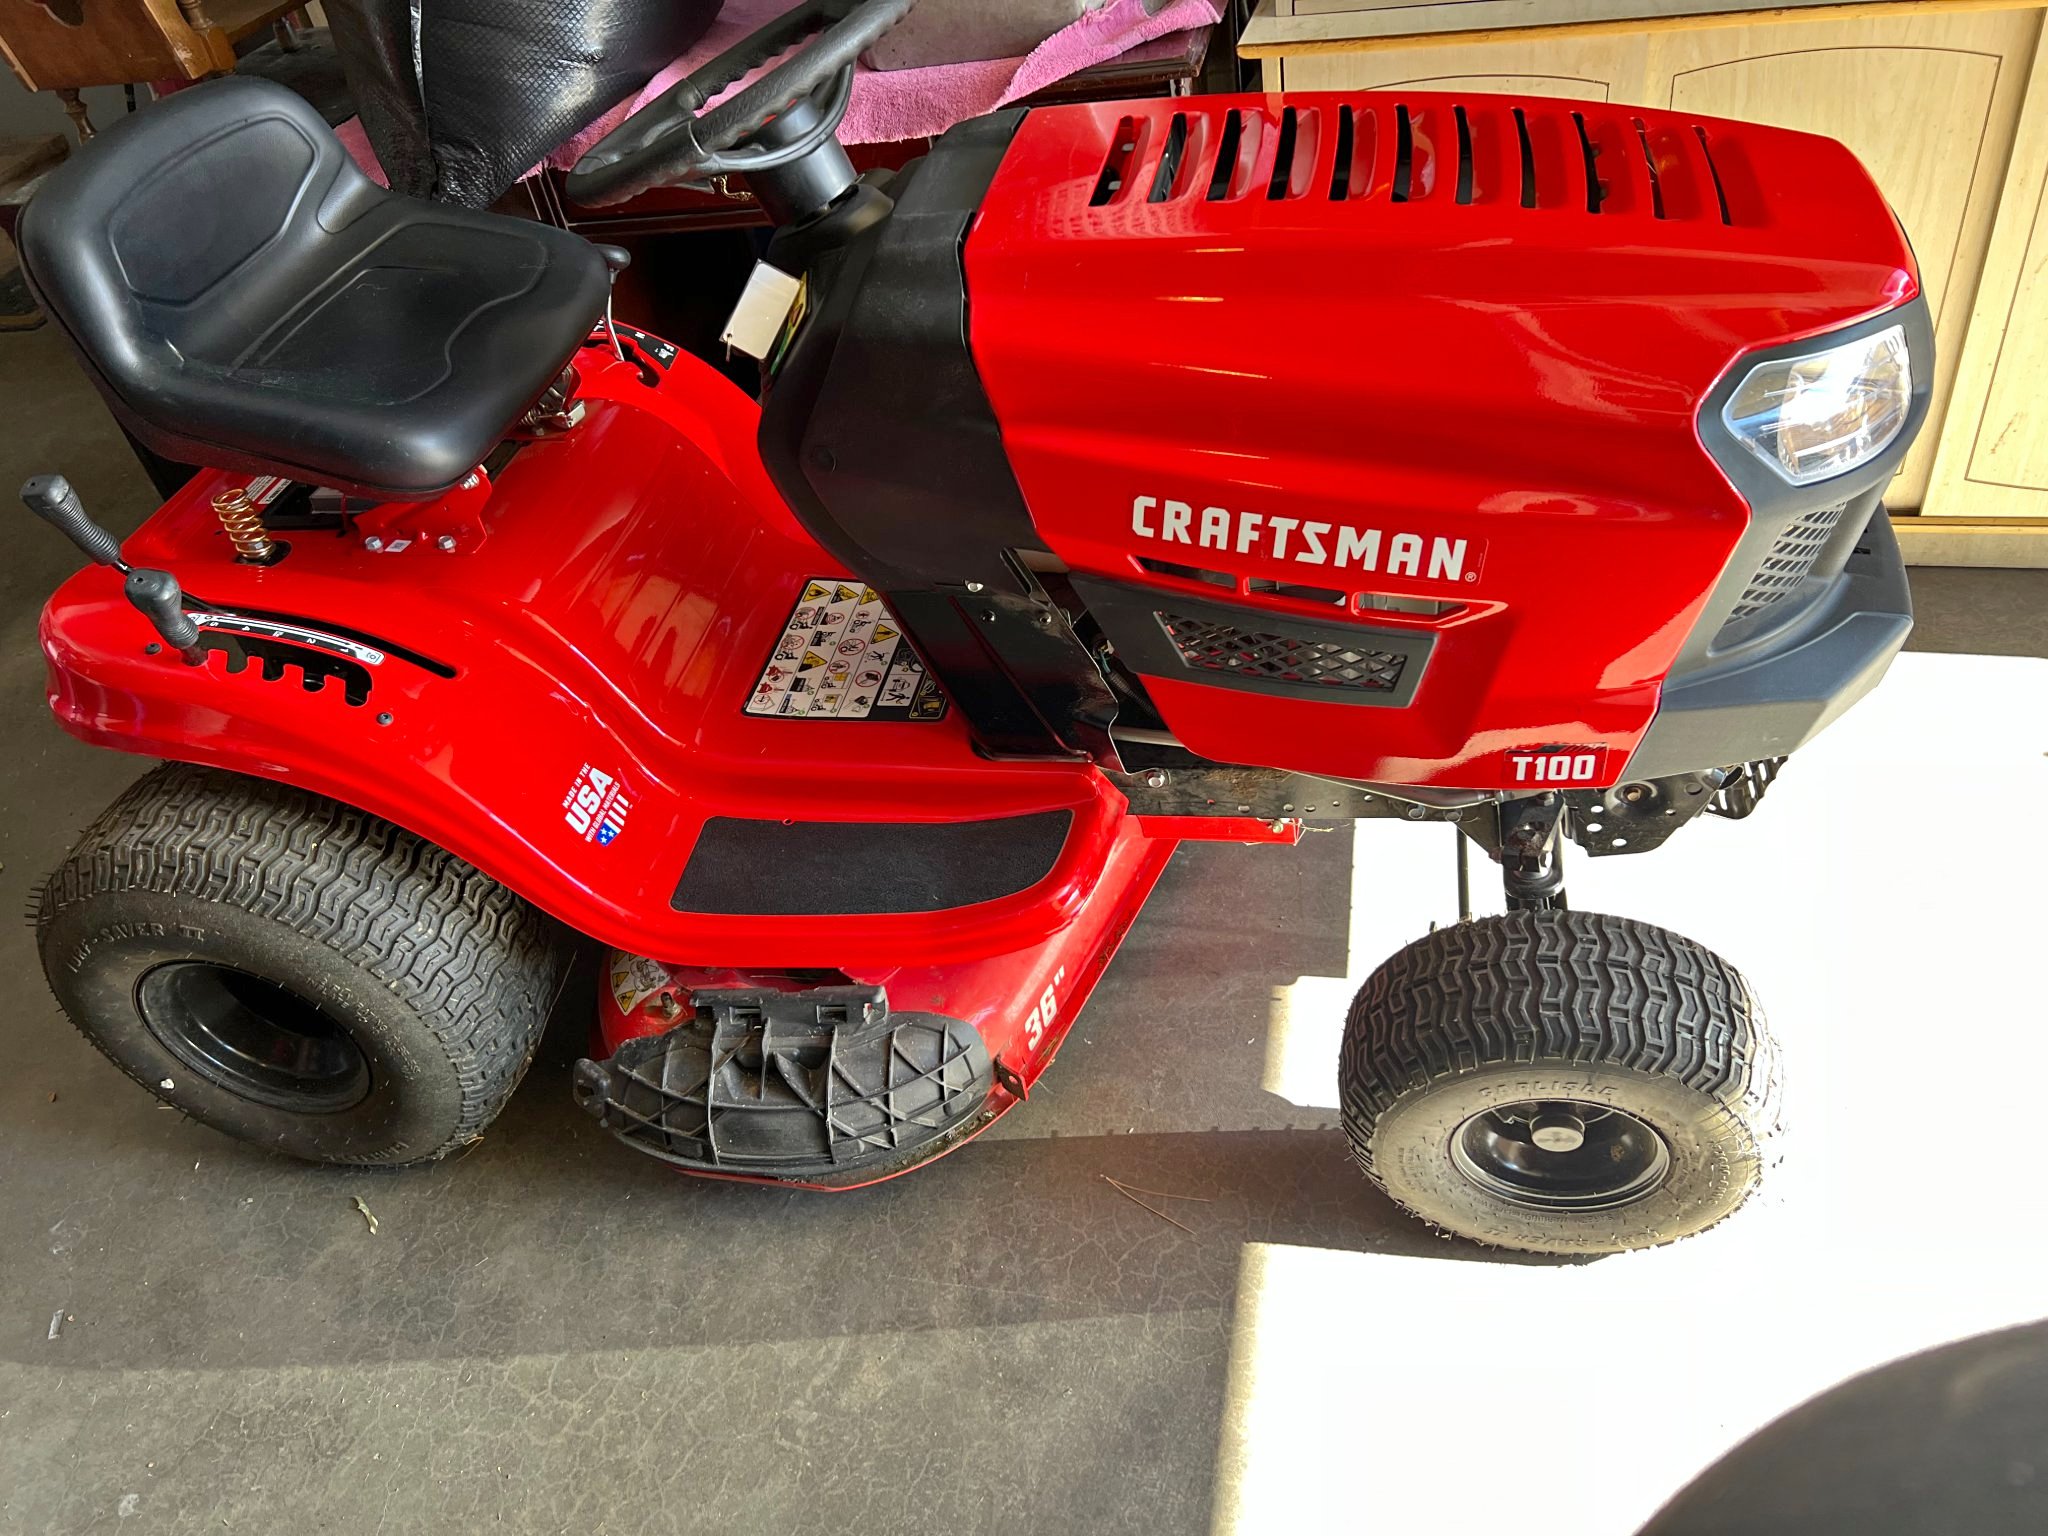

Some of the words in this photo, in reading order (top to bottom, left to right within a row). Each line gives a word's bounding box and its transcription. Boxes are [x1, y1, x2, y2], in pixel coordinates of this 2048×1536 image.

[1132, 495, 1468, 581] CRAFTSMAN
[562, 785, 578, 809] MADE
[573, 776, 583, 787] IN
[579, 762, 591, 778] THE
[1513, 754, 1595, 781] T100
[564, 767, 614, 835] USA
